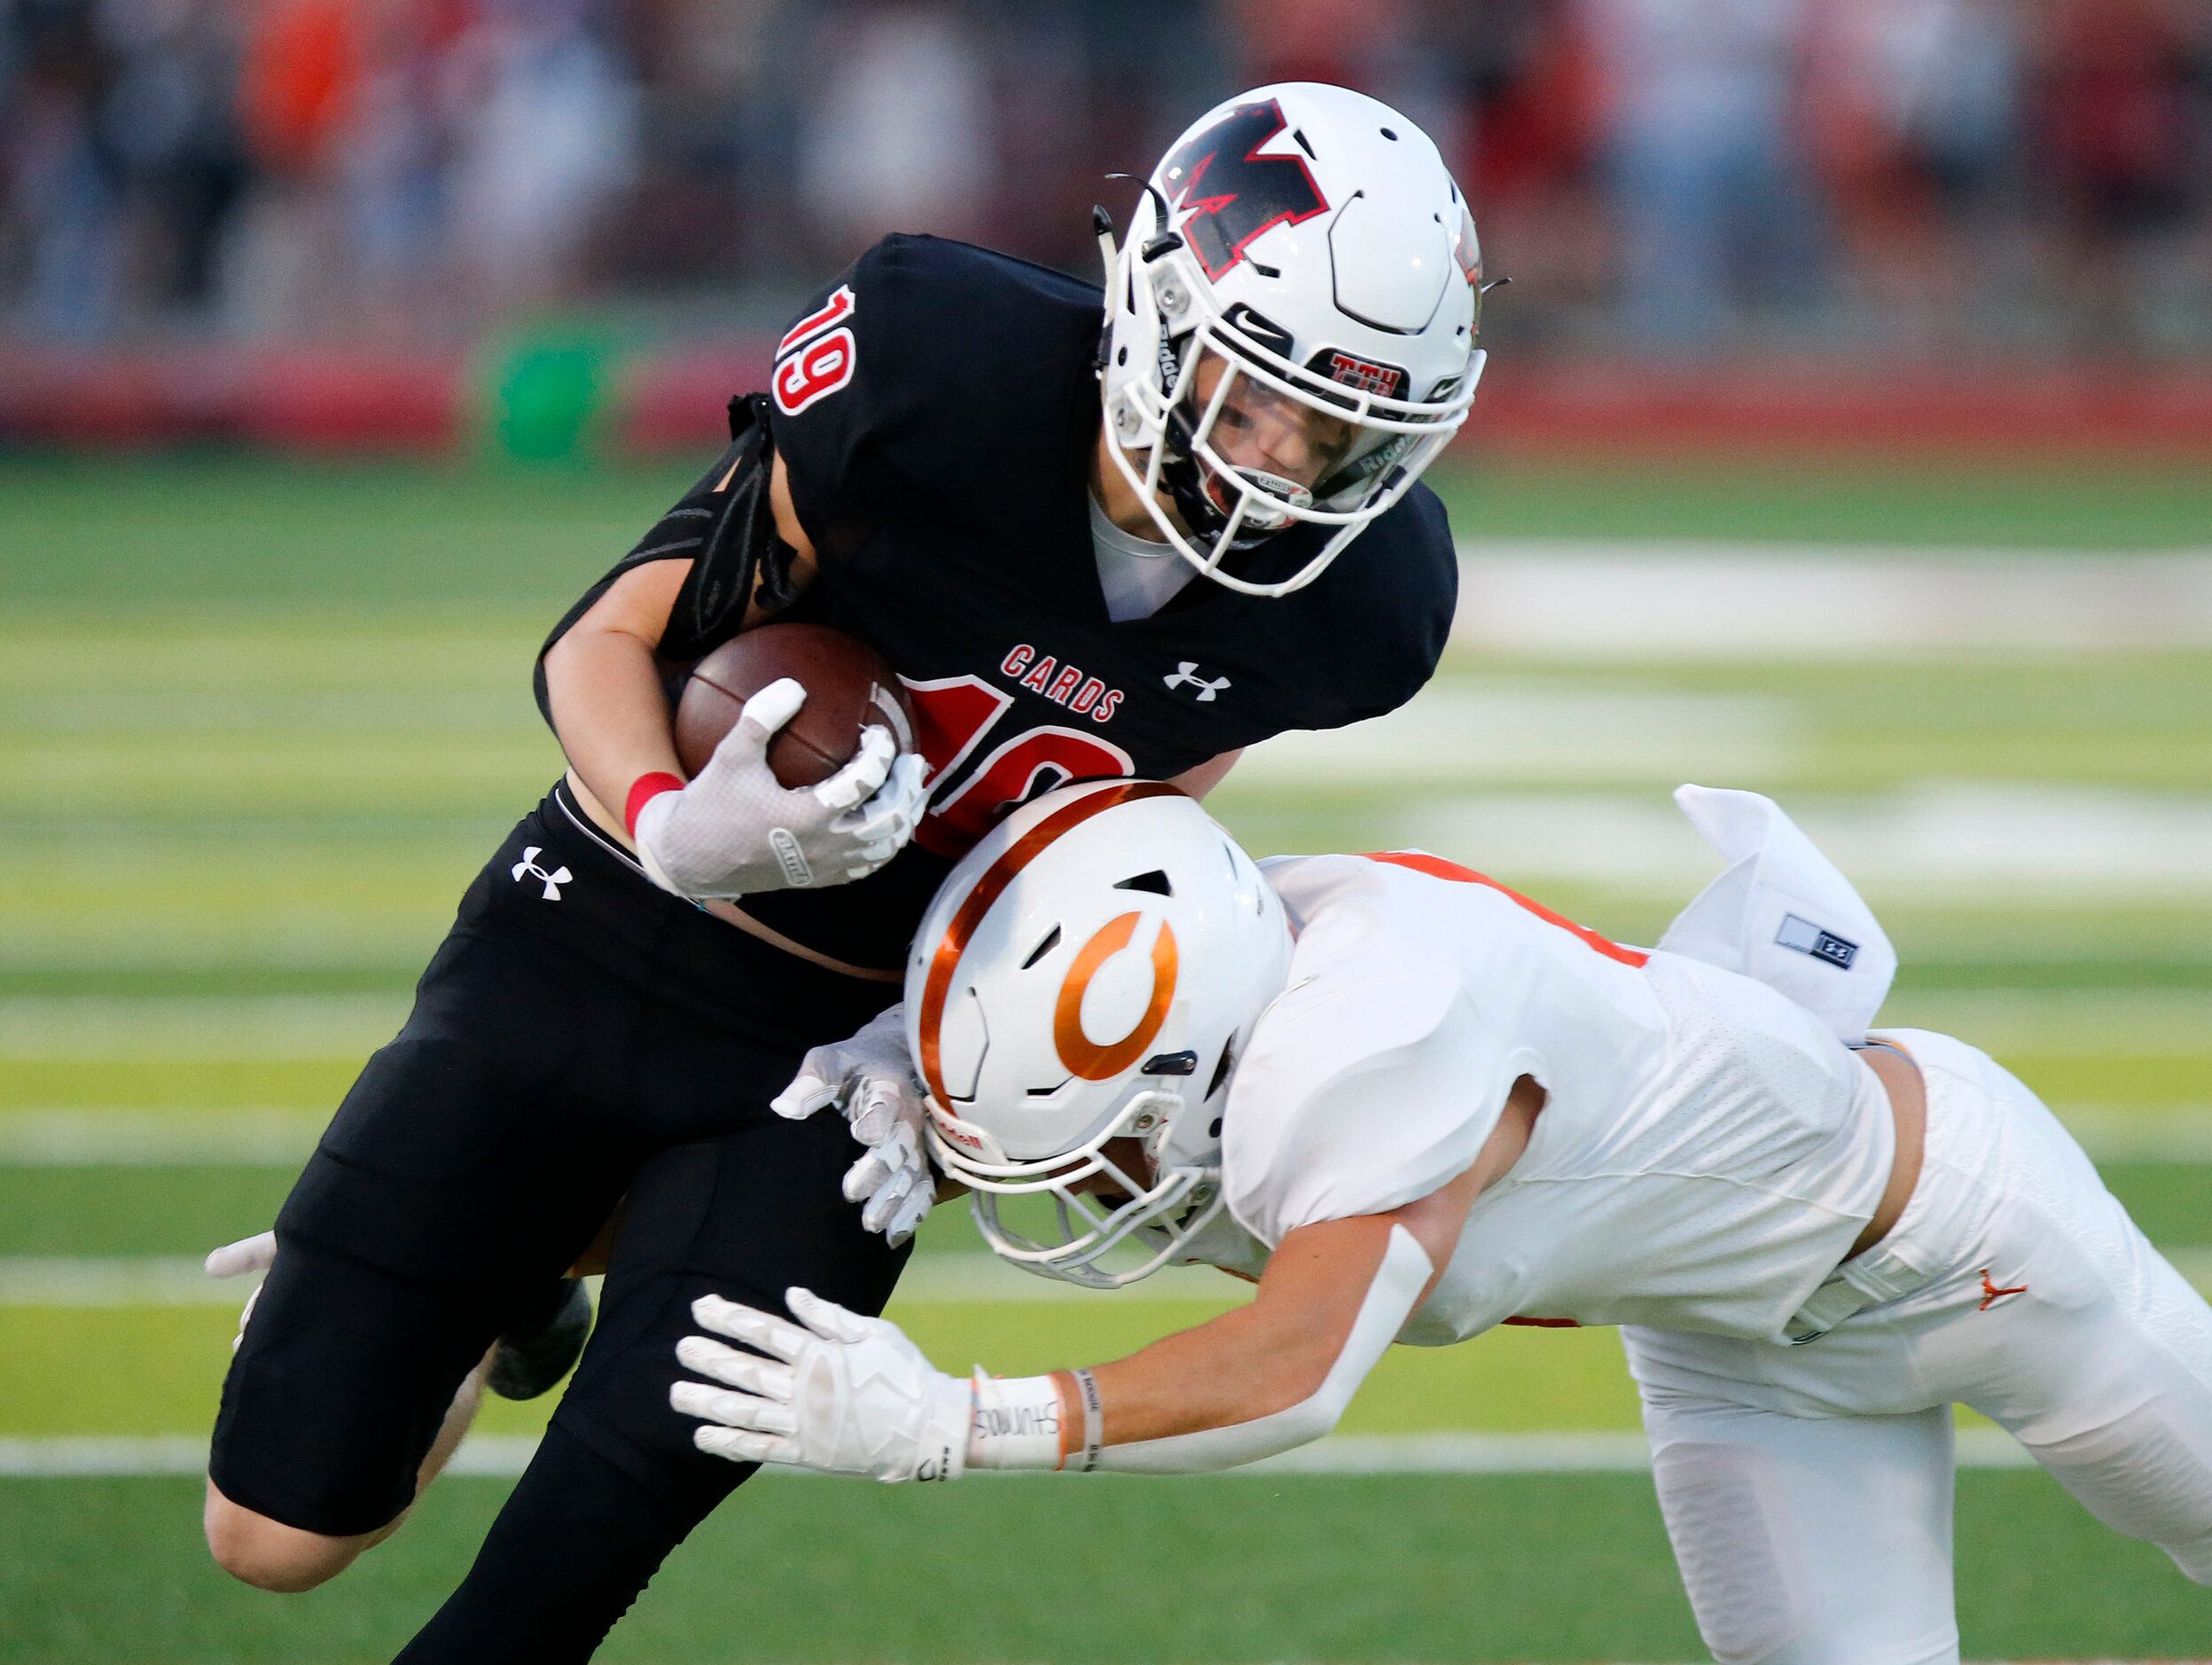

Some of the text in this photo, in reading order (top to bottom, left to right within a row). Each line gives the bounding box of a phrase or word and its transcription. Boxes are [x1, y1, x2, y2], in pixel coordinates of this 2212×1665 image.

[771, 284, 856, 417] 19
[999, 643, 1125, 723] CARDS
[1053, 910, 1180, 1082] C
